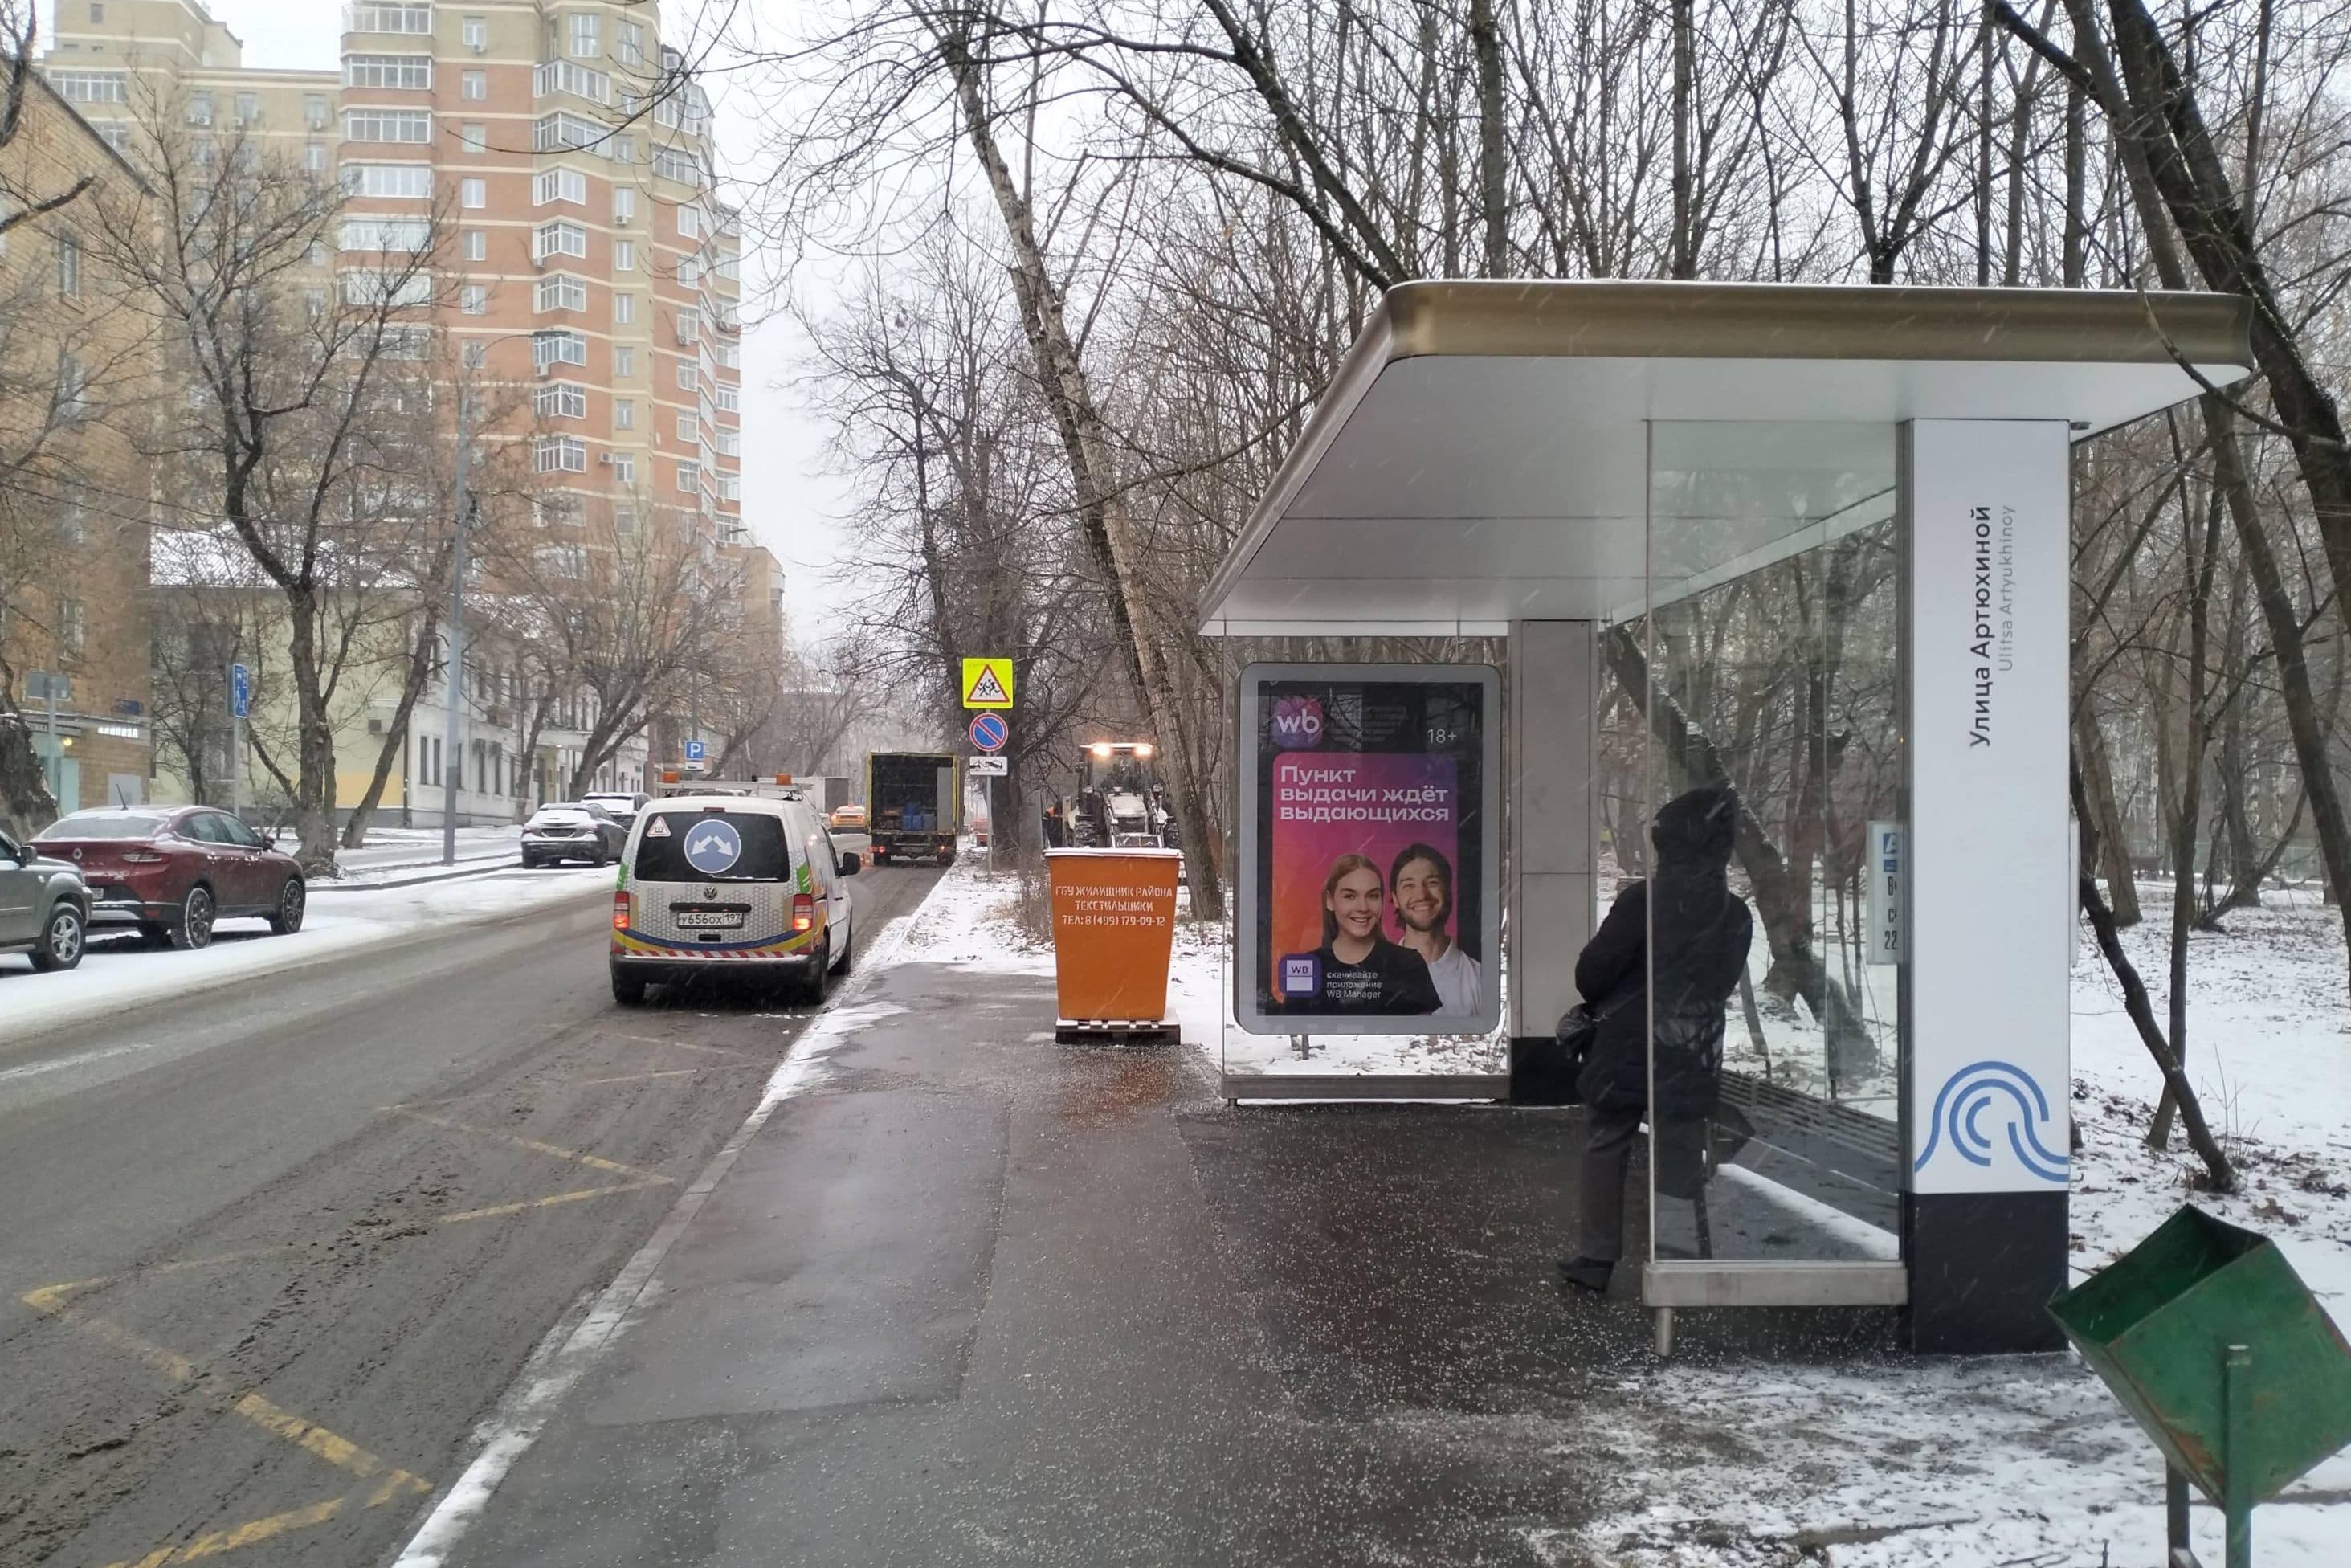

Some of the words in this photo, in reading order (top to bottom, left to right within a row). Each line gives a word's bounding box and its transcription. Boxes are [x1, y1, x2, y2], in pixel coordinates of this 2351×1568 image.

[1998, 504, 2016, 615] Artyukhinoy
[1970, 506, 1995, 659] Артюхиной
[1998, 620, 2013, 672] Ulitsa
[1969, 667, 1994, 746] Улица
[1427, 729, 1458, 744] 18+
[691, 743, 701, 757] P
[1280, 766, 1356, 786] Пункт
[1280, 788, 1377, 804] выдачи
[1382, 785, 1448, 804] ждёт
[1280, 806, 1449, 823] выдающихся
[1055, 886, 1074, 896] ГБУ
[1076, 886, 1134, 897] ЖИЛИЩНИК
[1136, 886, 1173, 897] РАЙОНА
[724, 913, 741, 922] 197
[1063, 915, 1084, 925] ТЕЛ:
[1085, 916, 1091, 925] 8
[1093, 916, 1119, 926] (499)
[1121, 916, 1165, 926] 179-09-12
[1326, 970, 1378, 978] скачивайте
[1326, 981, 1382, 990] приложение
[1344, 990, 1382, 1000] Manager
